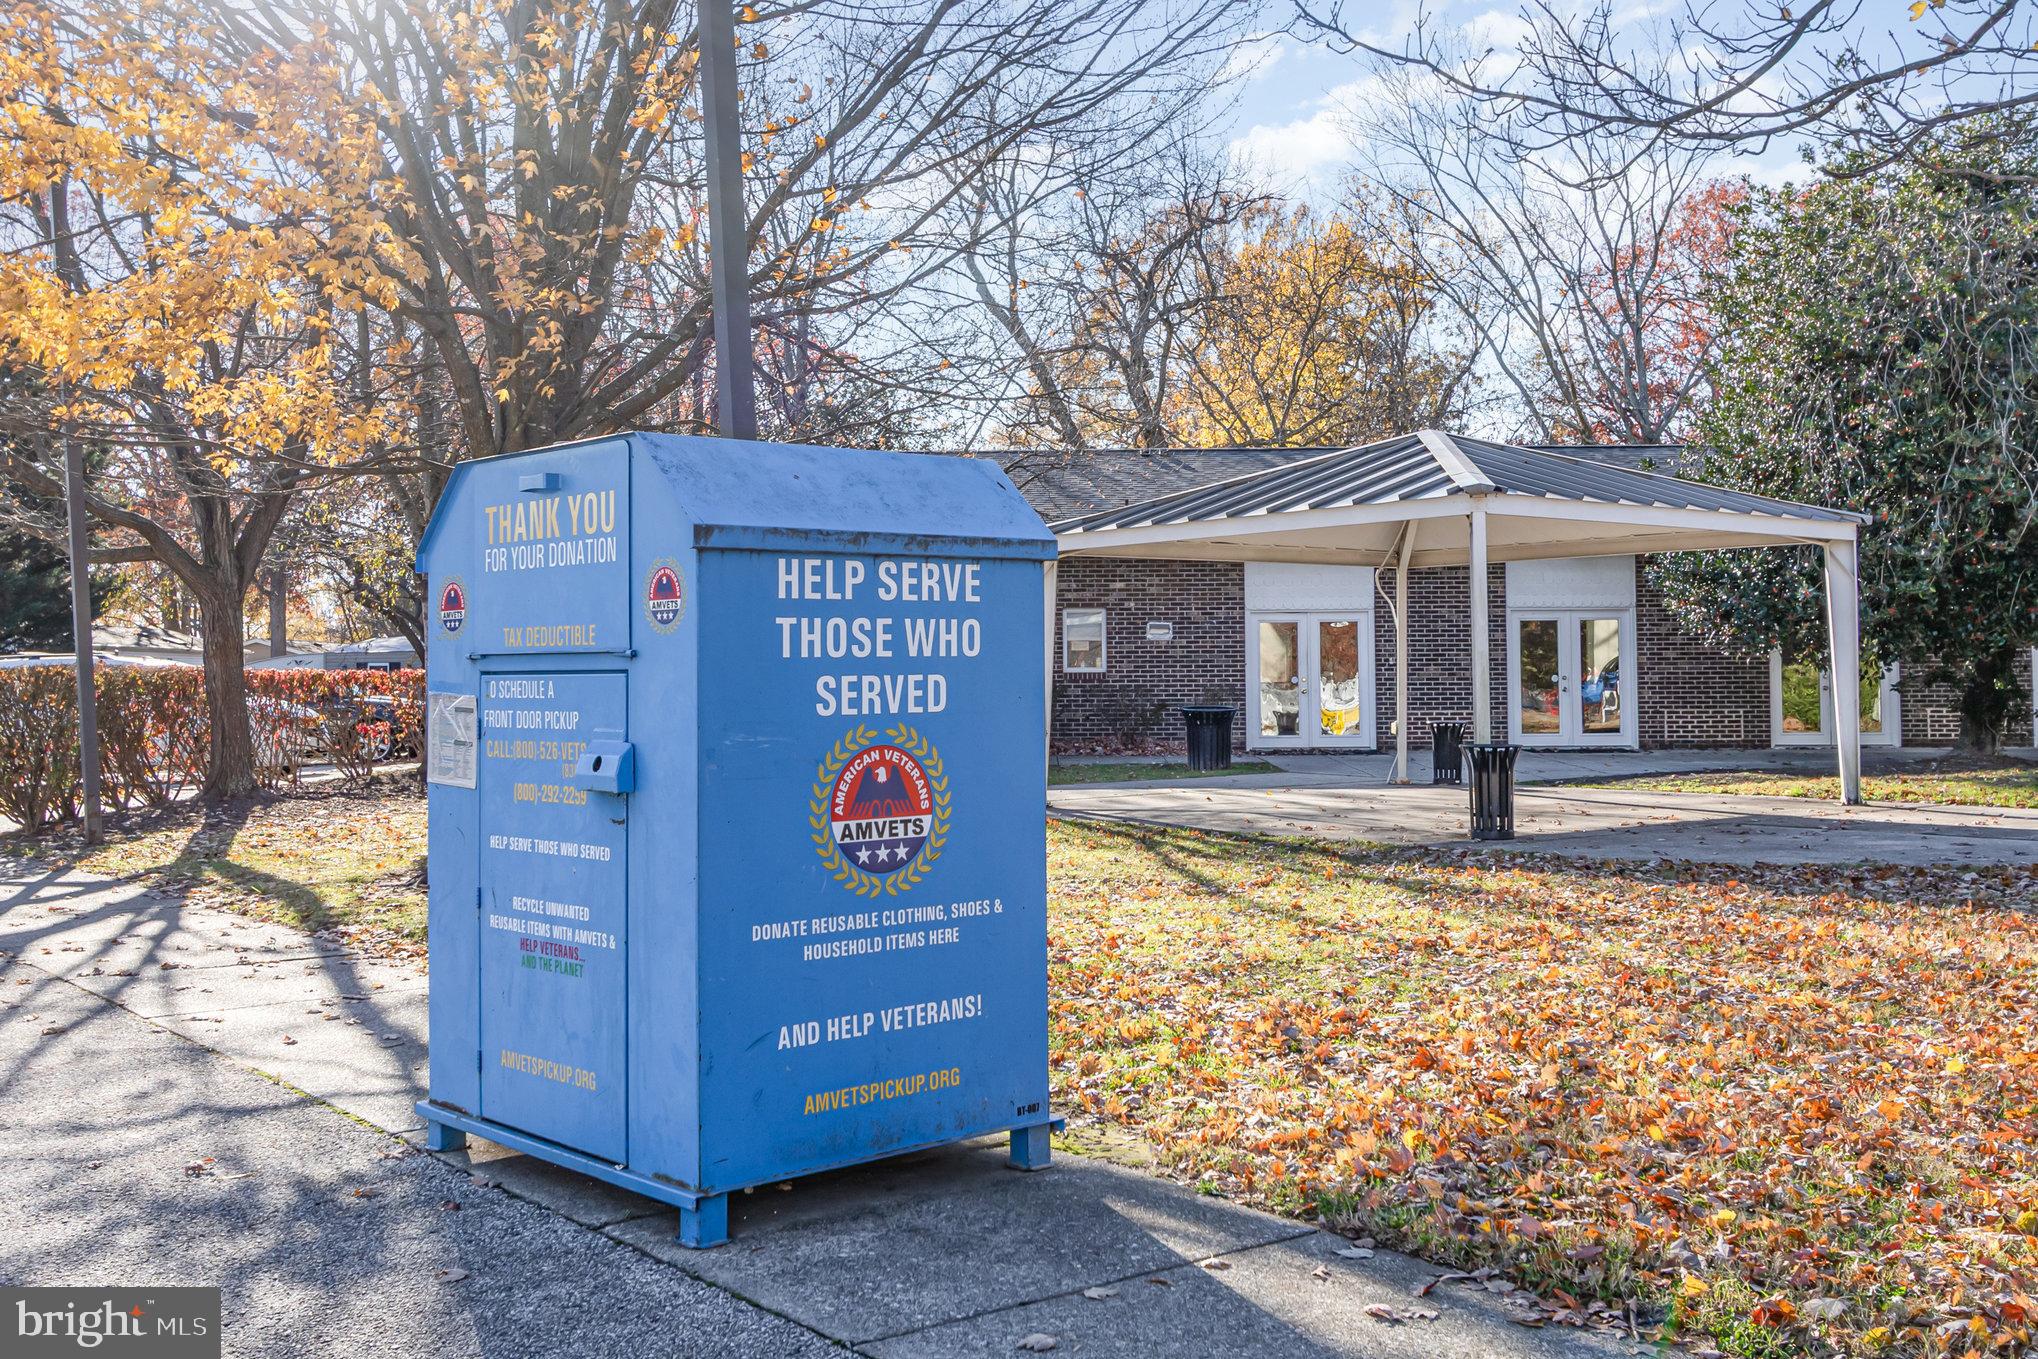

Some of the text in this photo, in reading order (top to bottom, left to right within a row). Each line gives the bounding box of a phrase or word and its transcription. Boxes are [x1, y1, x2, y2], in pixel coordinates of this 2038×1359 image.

[485, 490, 616, 545] THANK YOU
[485, 537, 617, 573] FOR YOUR DONATION
[778, 558, 981, 602] HELP SERVE
[652, 600, 679, 610] AMVETS
[503, 624, 596, 647] TAX DEDUCTIBLE
[775, 617, 981, 658] THOSE WHO
[499, 680, 545, 699] SCHEDULE
[548, 681, 555, 699] A
[816, 674, 947, 717] SERVED
[484, 710, 579, 730] FRONT DOOR PICKUP
[834, 749, 930, 816] AMERICAN VETERANS
[840, 817, 924, 842] AMVETS
[490, 835, 610, 862] HELP SERVE THOSE WHO SERVED
[512, 896, 589, 922] RECYCLE UNWANTED
[752, 898, 1003, 942] DONATE REUSABLE CLOTHING, SHOES &
[489, 914, 616, 950] REUSABLE ITEMS WITH AMVETS &
[520, 938, 538, 951] HELP
[803, 927, 959, 961] HOUSEHOLD ITEMS HERE
[521, 955, 584, 978] AND THE PLANET
[777, 994, 982, 1050] AND HELP VETERANS!
[501, 1050, 596, 1090] AMVETSPICKUP.ORG
[804, 1068, 960, 1115] AMVETSPICKUP.ORG
